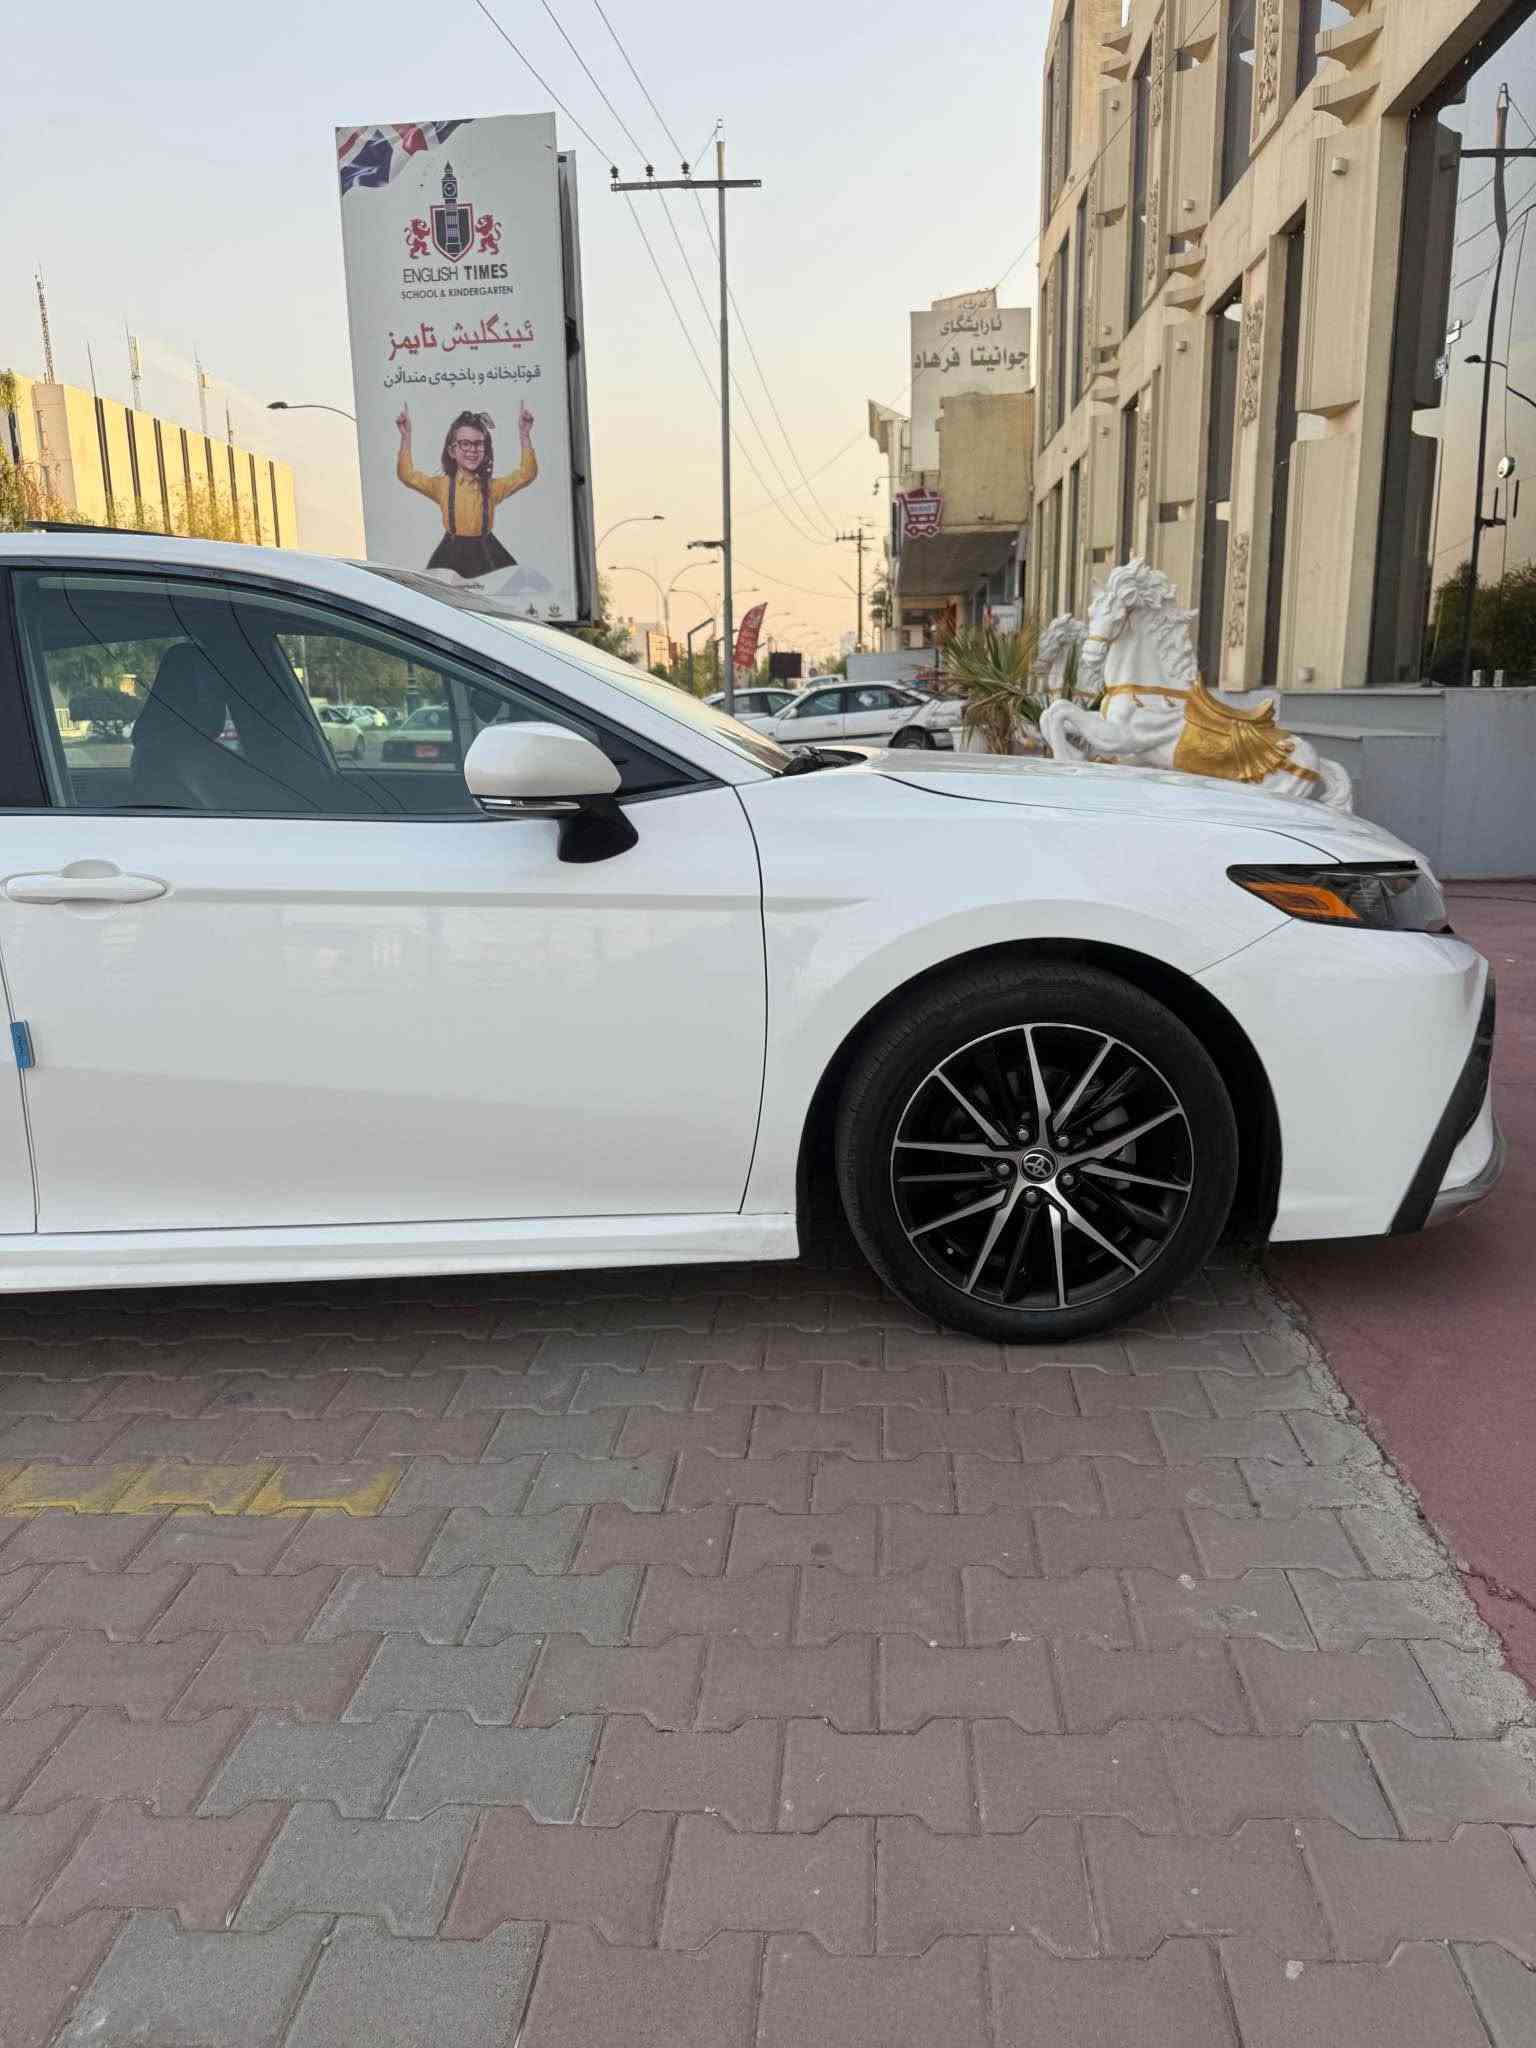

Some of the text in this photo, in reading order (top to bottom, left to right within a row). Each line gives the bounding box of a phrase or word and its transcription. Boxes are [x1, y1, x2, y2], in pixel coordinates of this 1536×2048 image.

[403, 263, 508, 283] ENGLISH TIMES
[401, 285, 514, 300] SCHOOL & KINDERGARTEN
[388, 313, 534, 361] ئینگلیش تایمز
